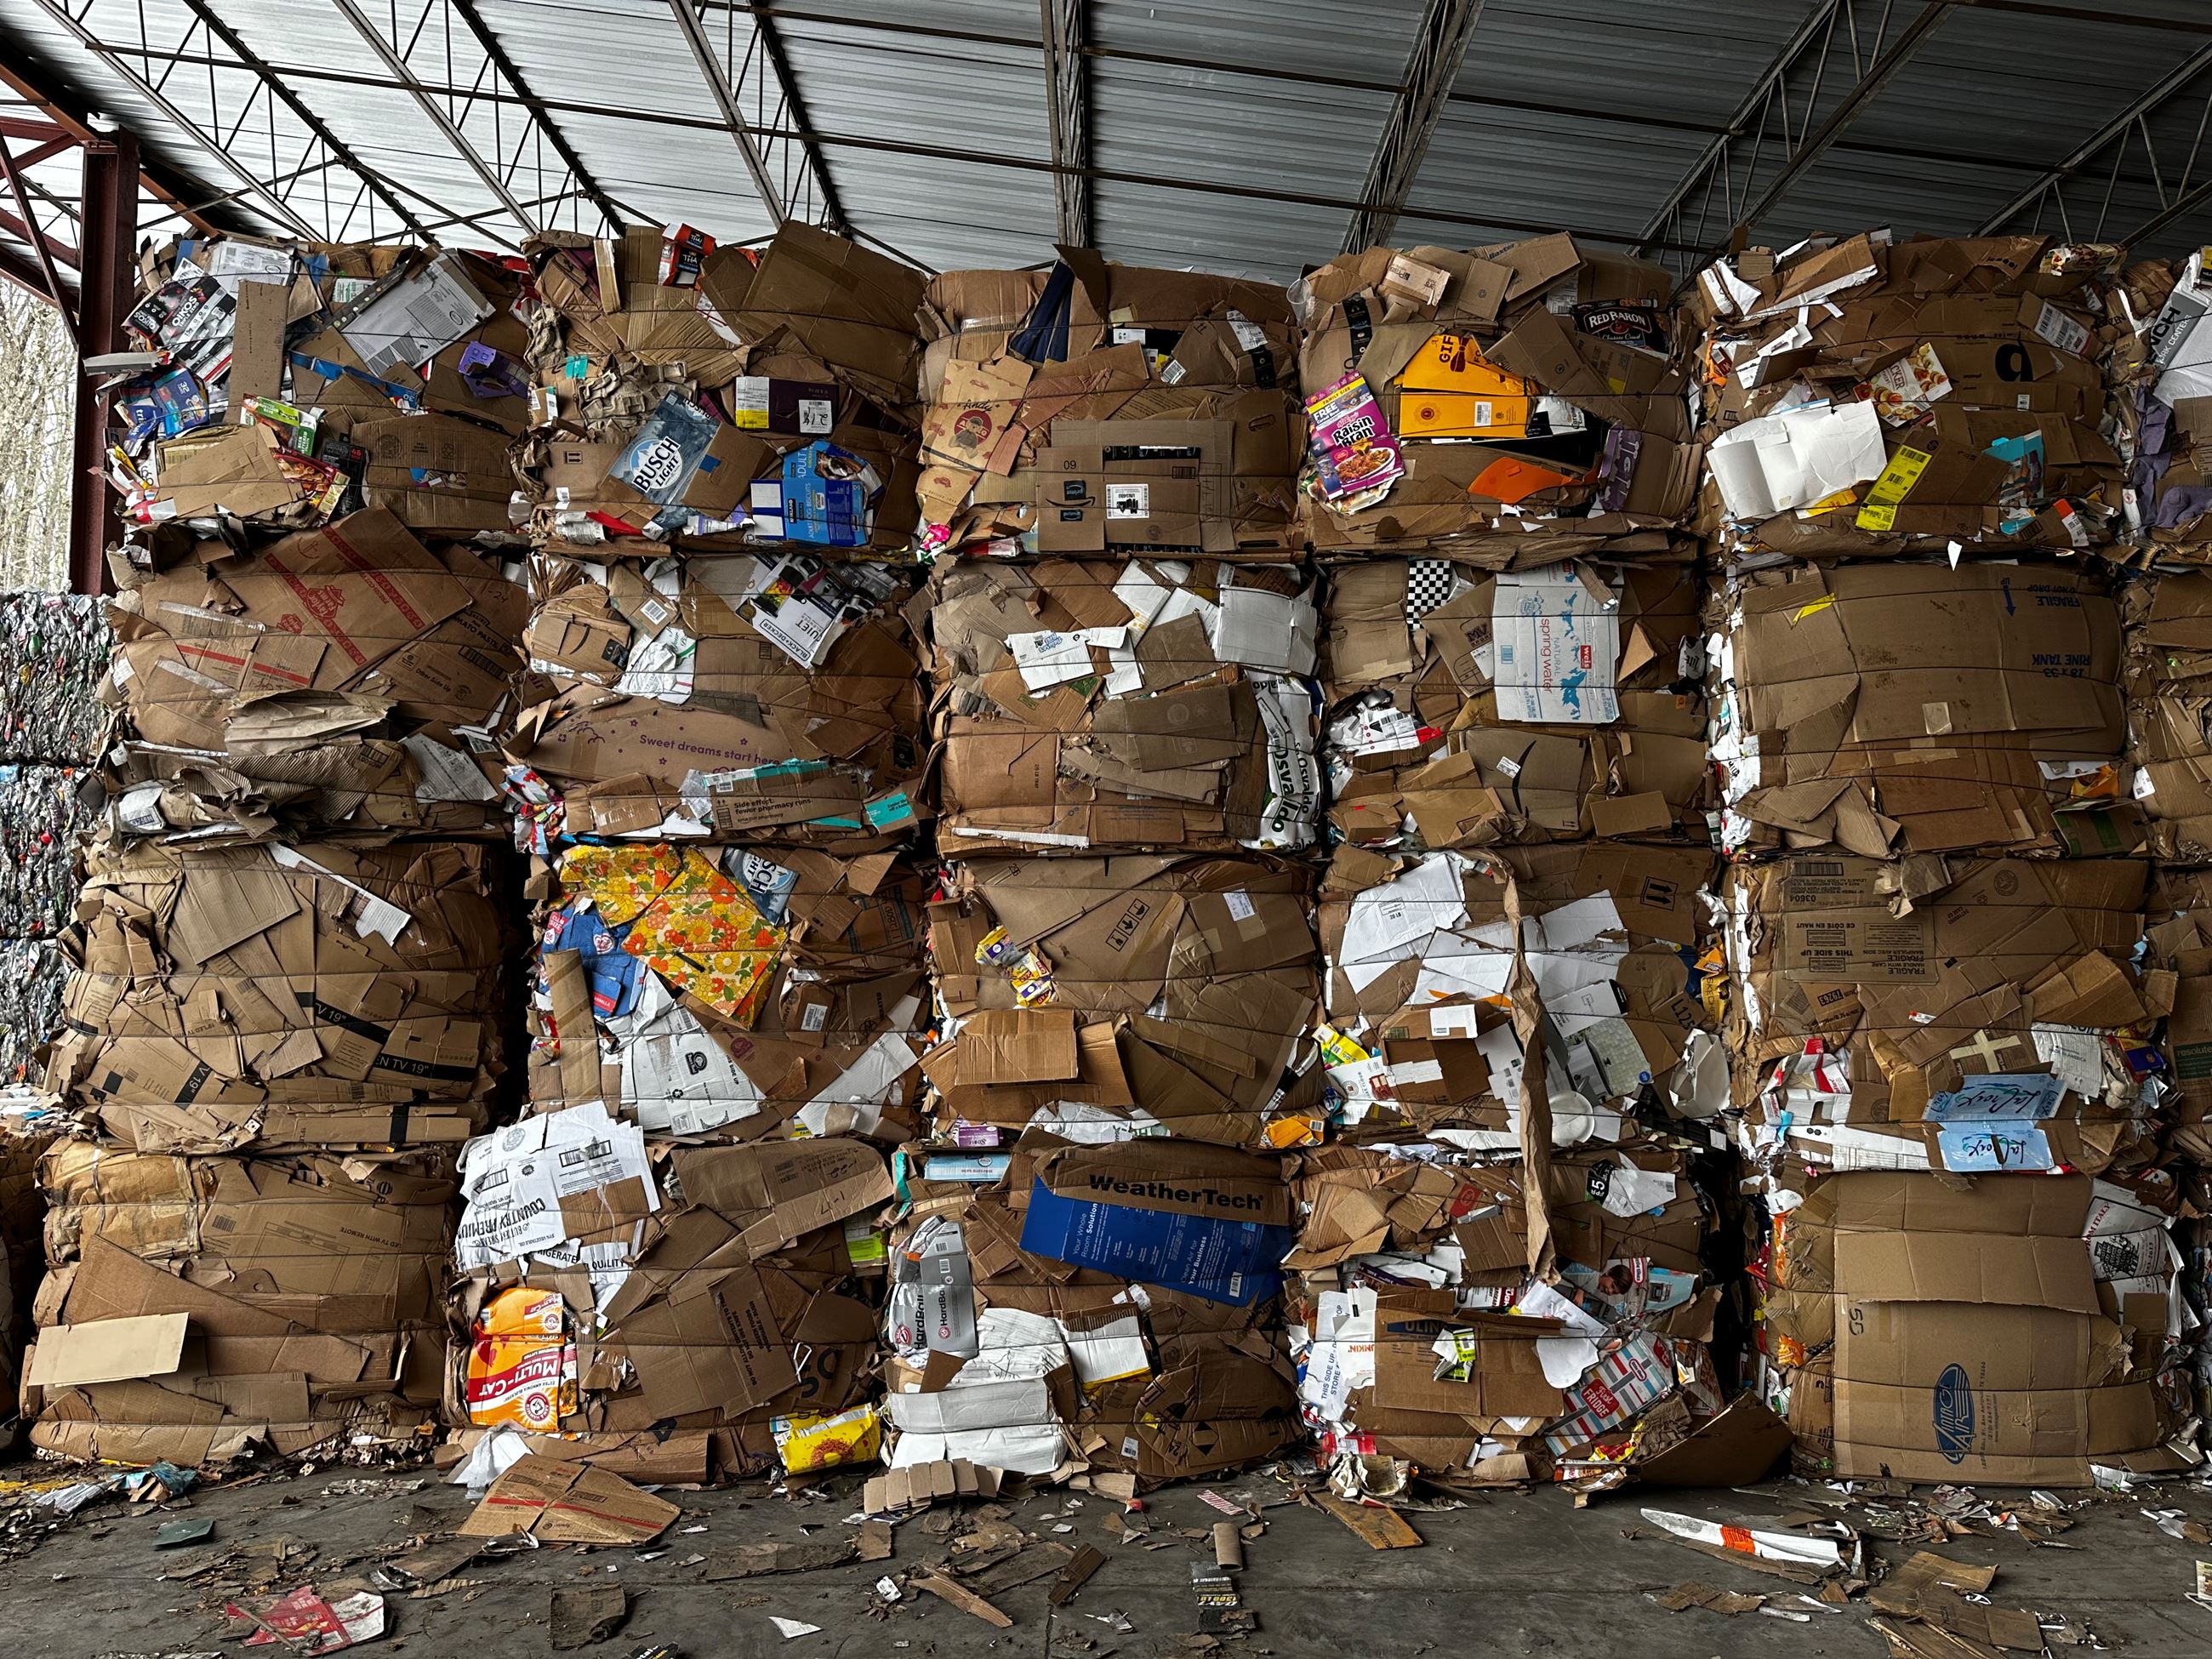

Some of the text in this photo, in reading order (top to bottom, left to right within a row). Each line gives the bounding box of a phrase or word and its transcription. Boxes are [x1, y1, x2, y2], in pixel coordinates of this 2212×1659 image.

[683, 254, 698, 265] THA
[1489, 242, 1516, 259] Baxter
[171, 295, 197, 327] OIKOS
[1588, 311, 1645, 328] RED BARON
[1323, 386, 1351, 405] FAMILY SIZE
[966, 400, 994, 414] Andy
[1314, 402, 1339, 422] FREE
[1333, 417, 1374, 442] Raisin
[1343, 426, 1374, 448] Bran
[635, 438, 680, 492] BUSCH
[655, 456, 680, 487] LIGHT
[798, 455, 809, 480] ADULT
[1063, 459, 1077, 470] 09
[2035, 596, 2081, 607] FRAGILE
[1540, 619, 1553, 694] spring water
[1554, 637, 1562, 676] NATURAL
[2031, 653, 2062, 666] TANK
[639, 733, 676, 750] Sweet
[676, 741, 721, 757] dreams
[723, 749, 751, 762] start
[1297, 755, 1312, 815] Osvaldo
[733, 800, 750, 809] Side
[734, 806, 757, 815] fewer
[757, 801, 794, 814] pharmacy
[1789, 894, 1816, 903] 03604
[1819, 989, 1842, 1006] 79263
[392, 1058, 430, 1075] TV 19"
[1967, 1137, 2027, 1165] LaCoix
[1090, 1173, 1263, 1211] WeatherTech
[499, 1197, 547, 1229] COUNTRY
[2095, 1201, 2112, 1224] ITALY
[339, 1227, 365, 1239] REMOTE
[365, 1234, 380, 1243] WITH
[1072, 1212, 1087, 1256] Your Whole
[1080, 1202, 1098, 1258] Room Solution
[1187, 1236, 1207, 1285] Your Business
[478, 1360, 558, 1397] MULTI-CAT
[1325, 1364, 1334, 1382] SIDE
[1331, 1371, 1342, 1396] STORE
[1321, 1383, 1330, 1400] THIS
[1583, 1388, 1610, 1418] FRIDGE
